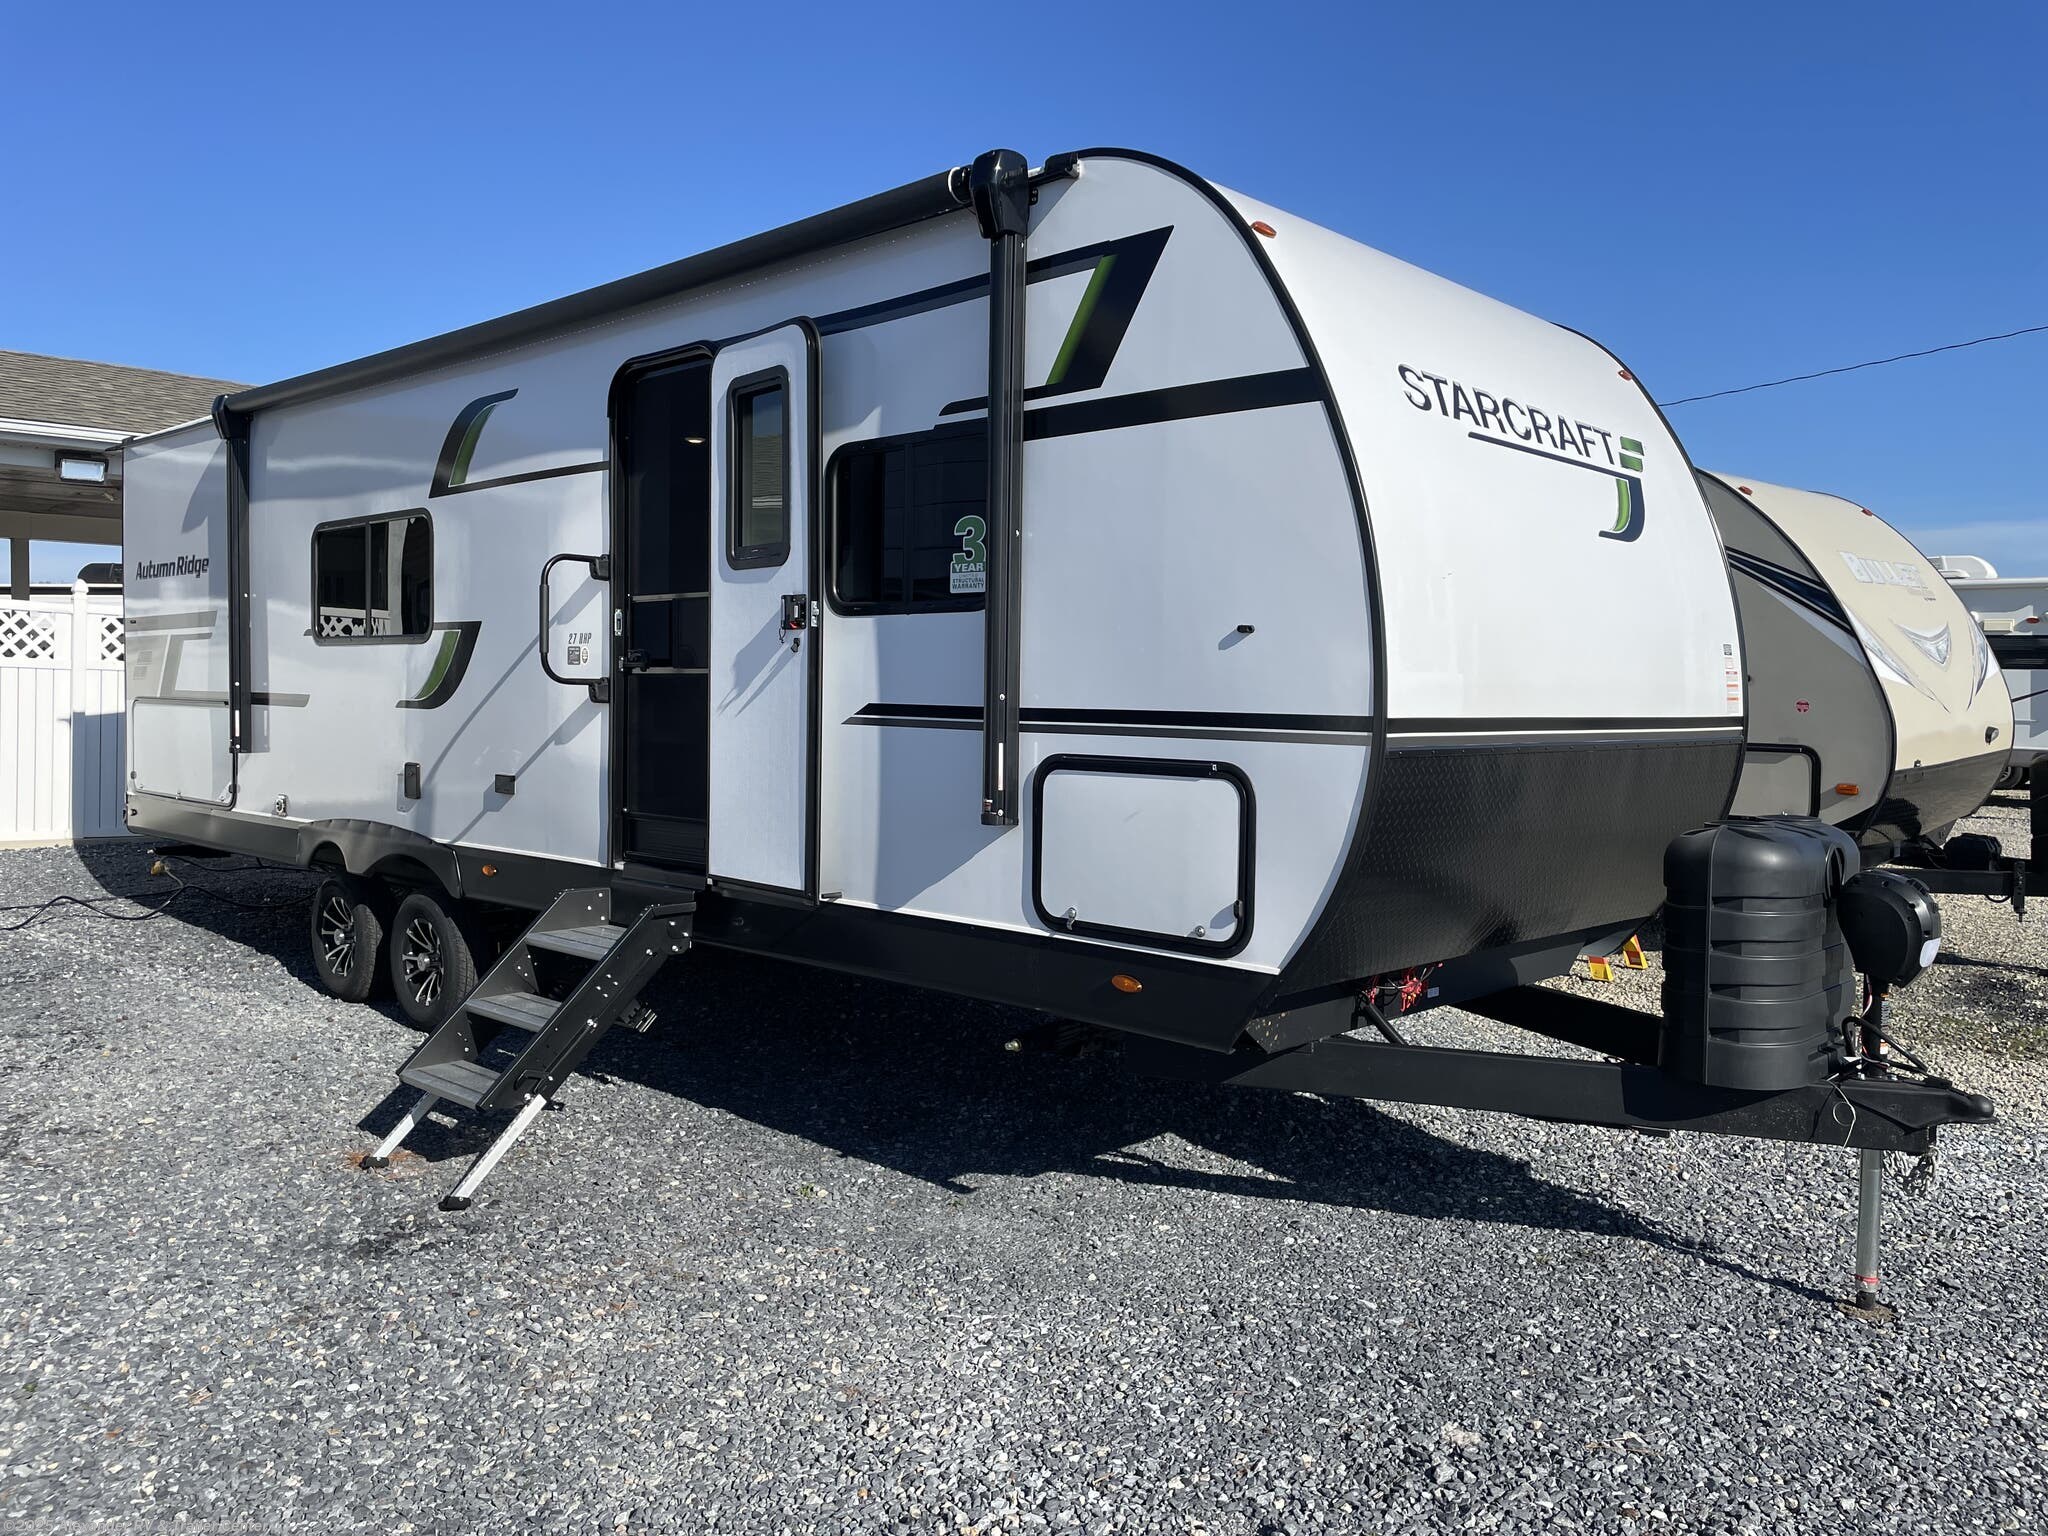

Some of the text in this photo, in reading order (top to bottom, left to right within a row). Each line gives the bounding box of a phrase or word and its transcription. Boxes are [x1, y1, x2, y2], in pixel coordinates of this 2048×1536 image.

[1398, 363, 1615, 466] STARCRAFT
[953, 515, 986, 563] 3
[136, 554, 210, 580] Autumn Ridge
[954, 563, 984, 572] YEAR
[568, 633, 577, 644] 27
